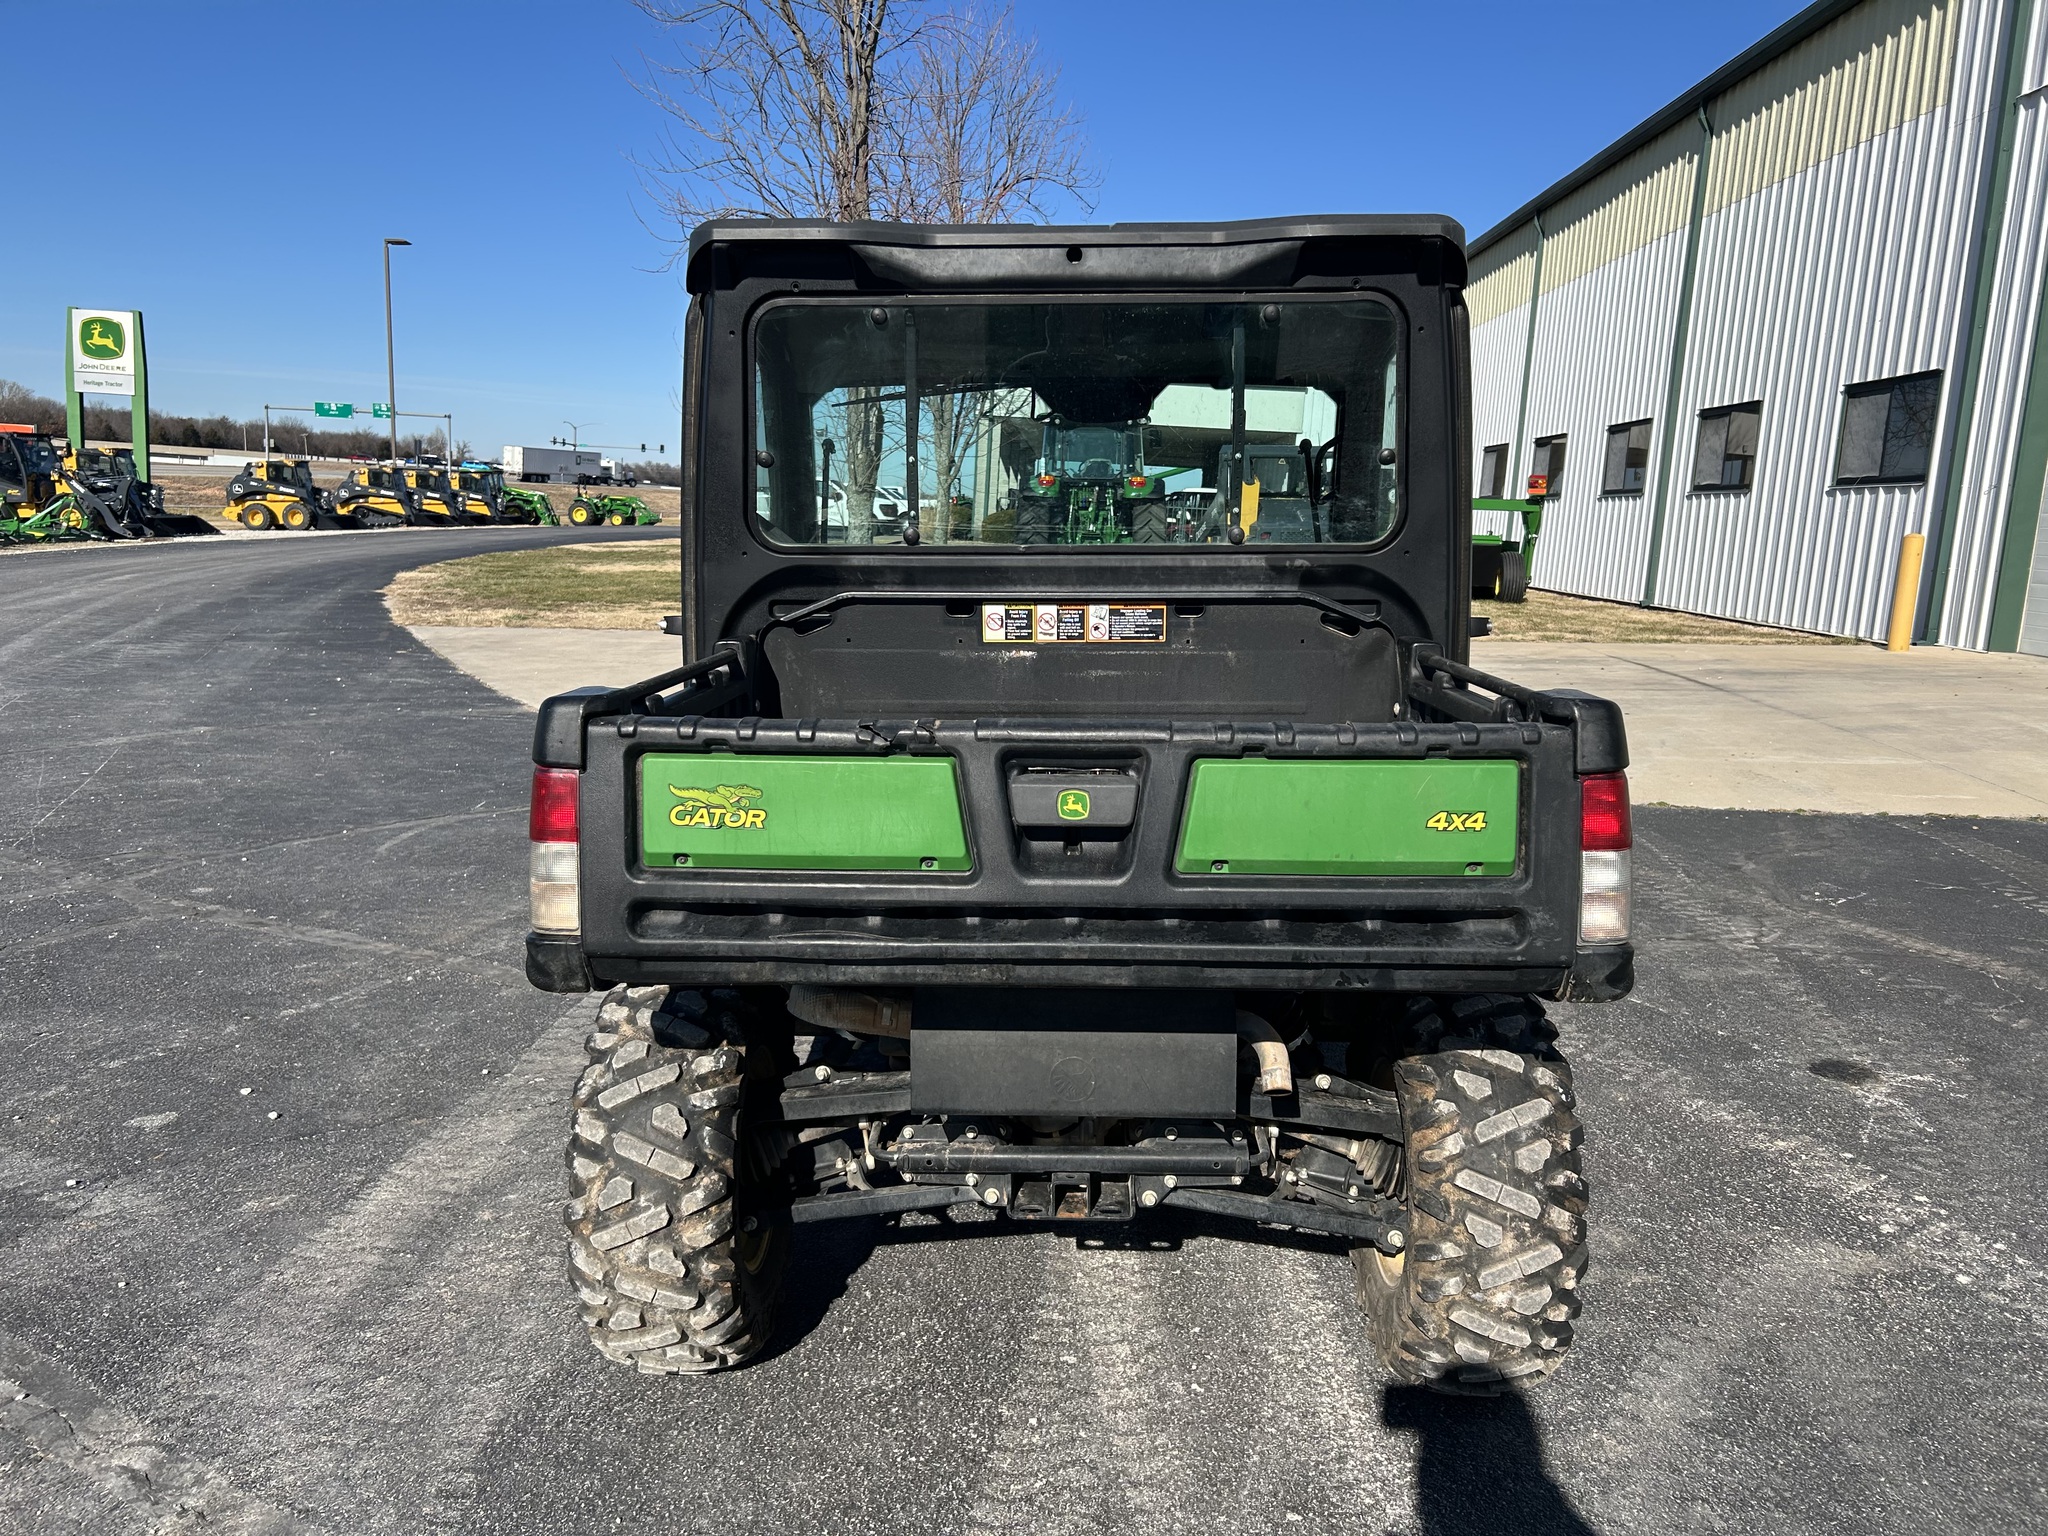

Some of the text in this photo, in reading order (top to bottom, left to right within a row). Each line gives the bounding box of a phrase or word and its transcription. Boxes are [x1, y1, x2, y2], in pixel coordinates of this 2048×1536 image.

[78, 362, 126, 372] JOHN DEERE
[83, 379, 103, 387] Heritage
[669, 804, 767, 829] GATOR
[1425, 811, 1488, 832] 4x4
